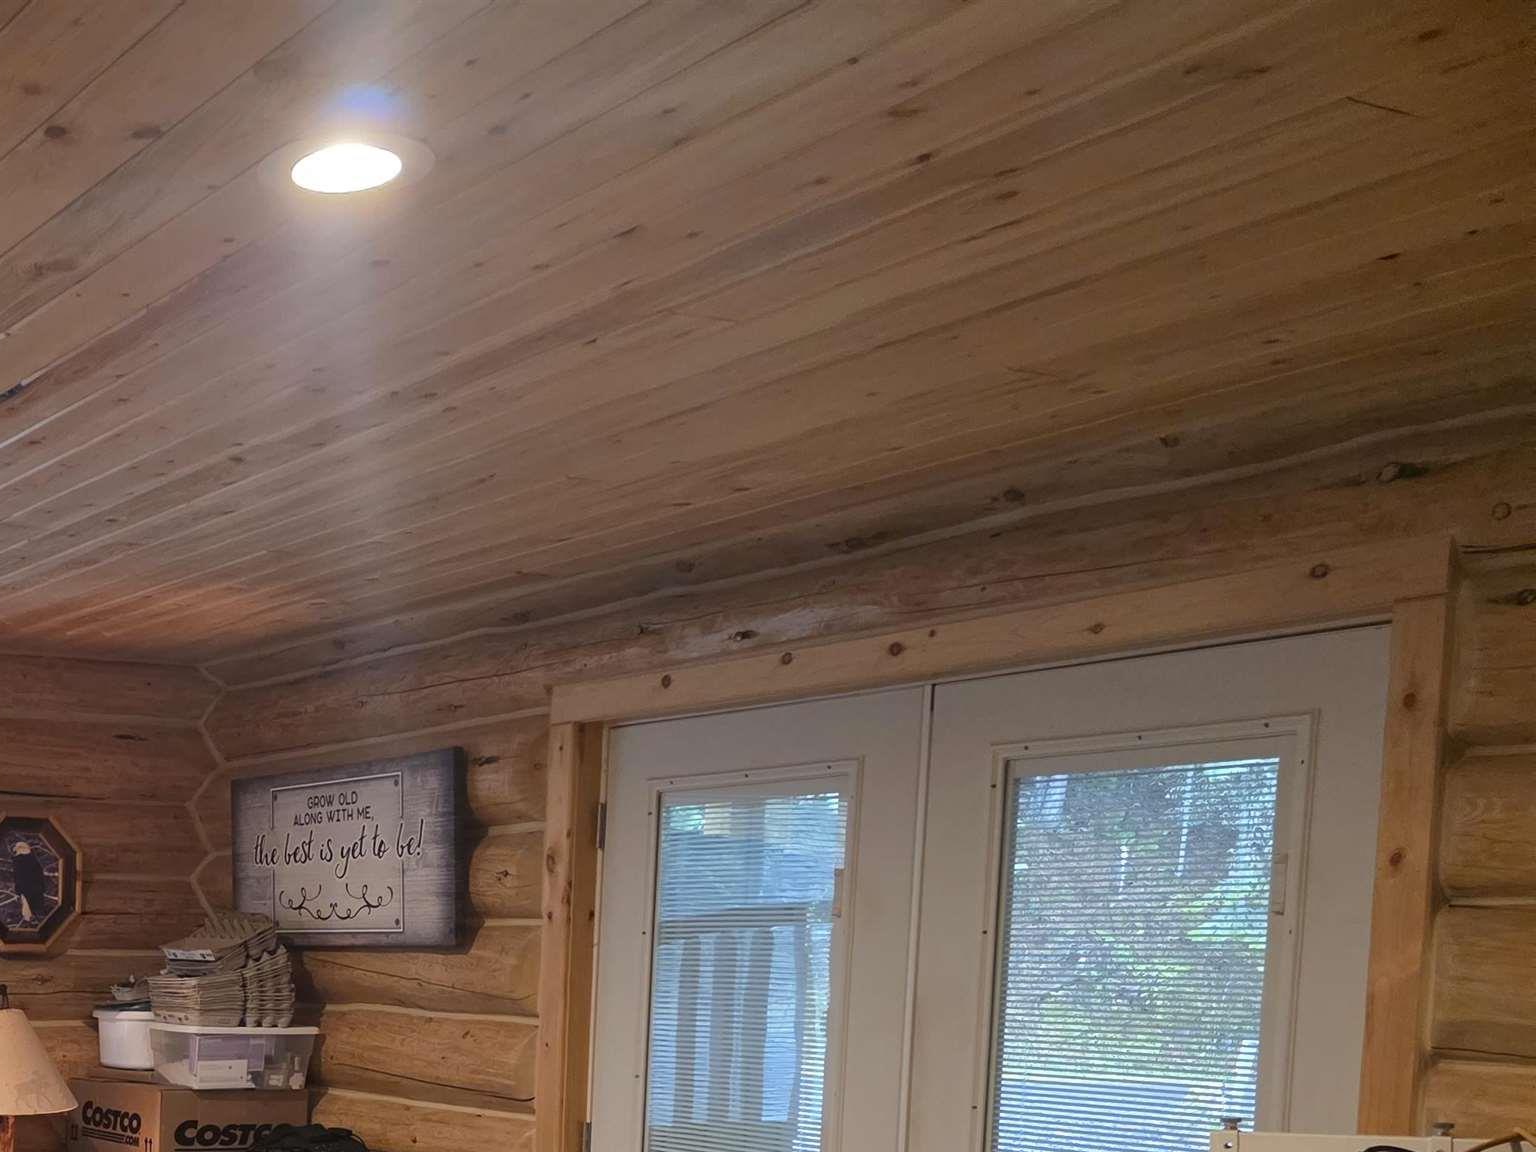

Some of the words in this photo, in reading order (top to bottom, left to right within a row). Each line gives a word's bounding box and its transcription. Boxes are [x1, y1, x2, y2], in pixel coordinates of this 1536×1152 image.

[307, 794, 334, 810] GROW
[338, 790, 358, 806] OLD
[293, 812, 323, 826] ALONG
[327, 808, 353, 822] WITH
[357, 805, 374, 821] ME,
[254, 834, 280, 866] the
[284, 831, 314, 865] best
[320, 839, 333, 863] is
[335, 825, 367, 879] yet
[372, 823, 389, 858] to
[396, 818, 424, 858] be!
[82, 1100, 141, 1134] COSTCO
